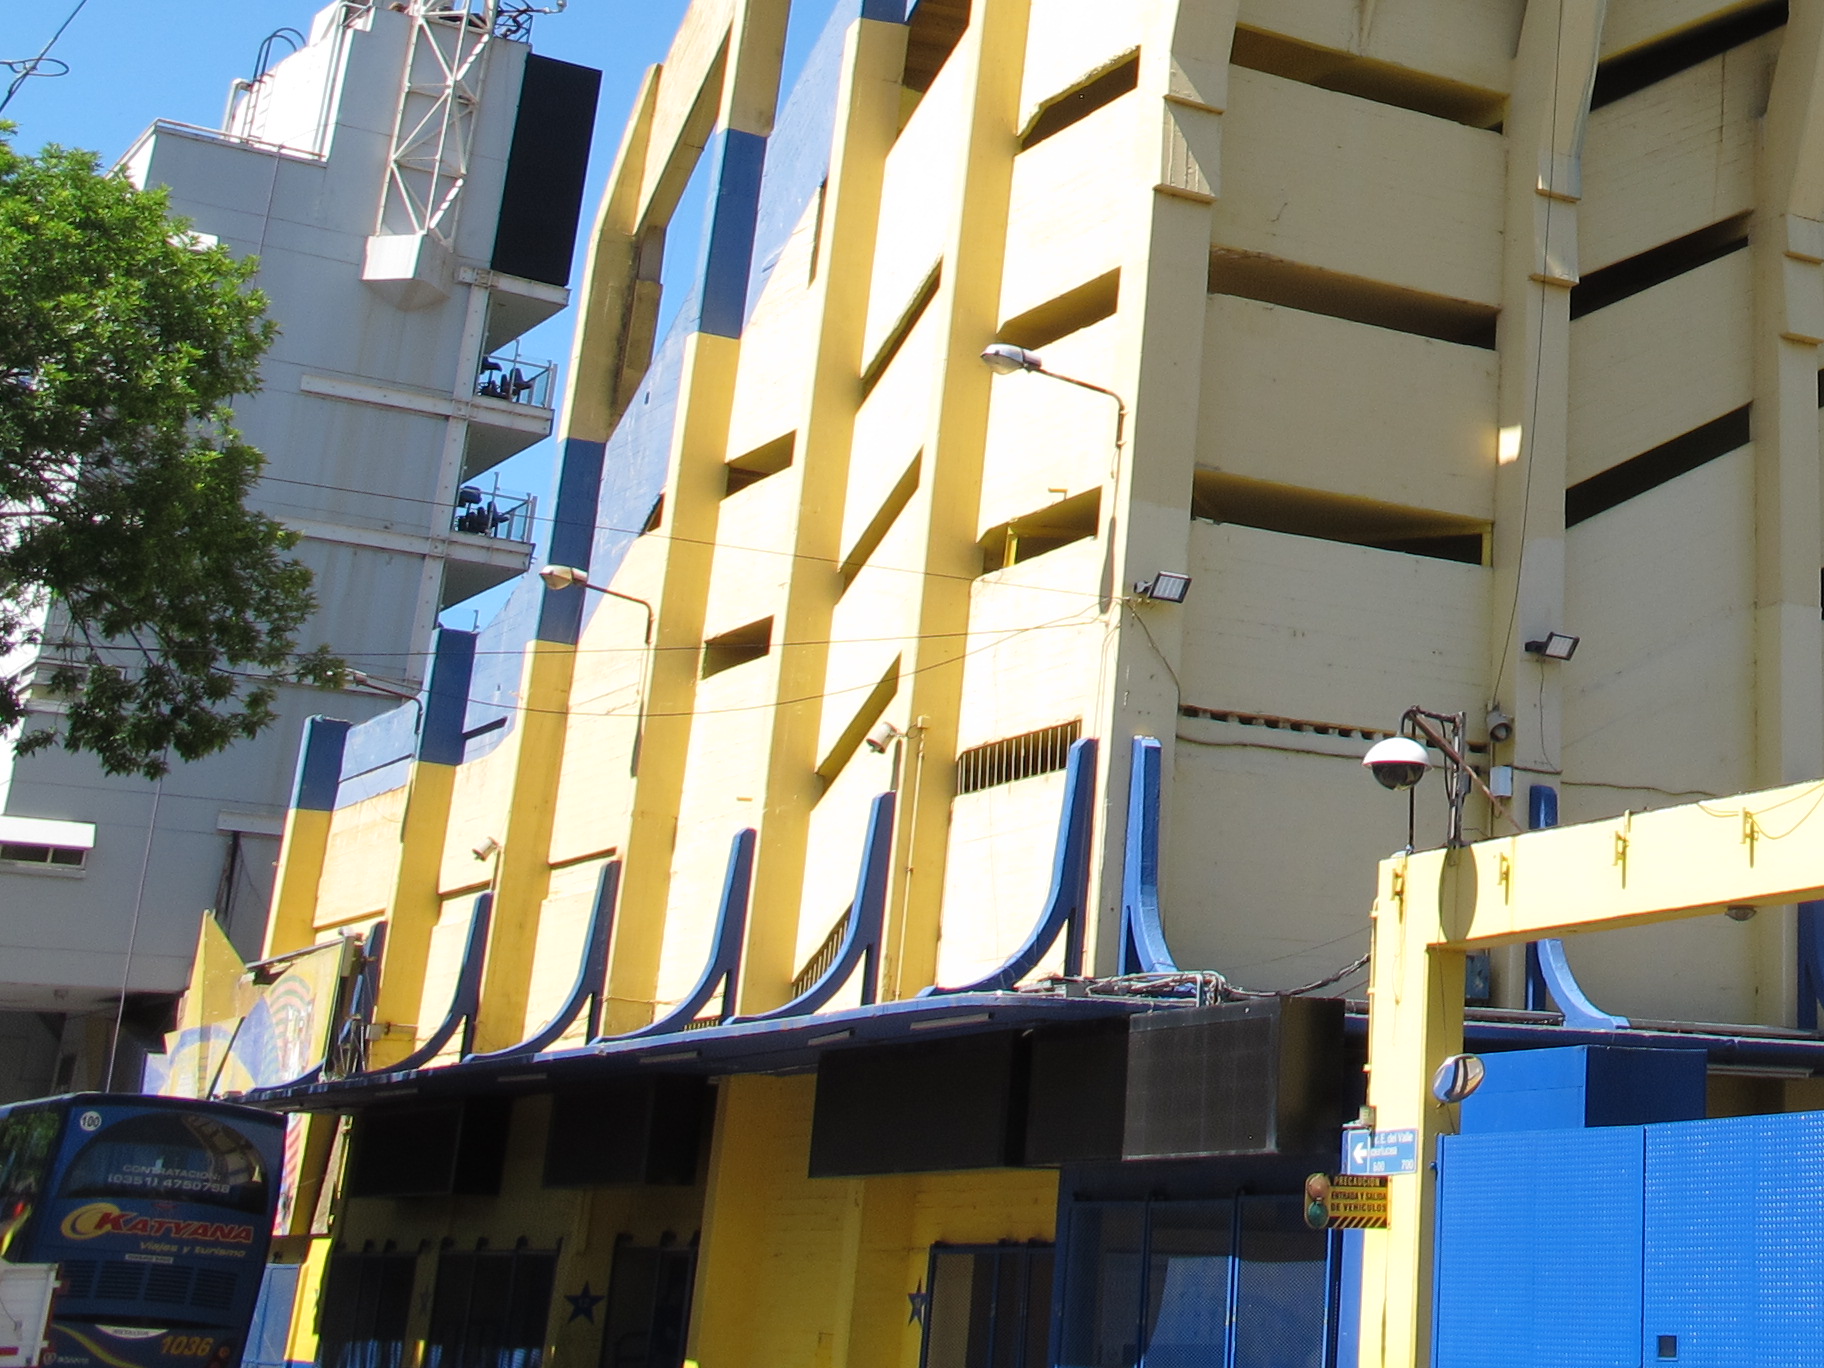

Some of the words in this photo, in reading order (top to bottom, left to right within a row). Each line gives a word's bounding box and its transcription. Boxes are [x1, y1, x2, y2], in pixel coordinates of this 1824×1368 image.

[82, 1115, 100, 1128] 100
[1401, 1159, 1414, 1170] 700
[1331, 1202, 1341, 1212] DE
[94, 1210, 254, 1244] KATYANA
[160, 1335, 215, 1357] 1036
